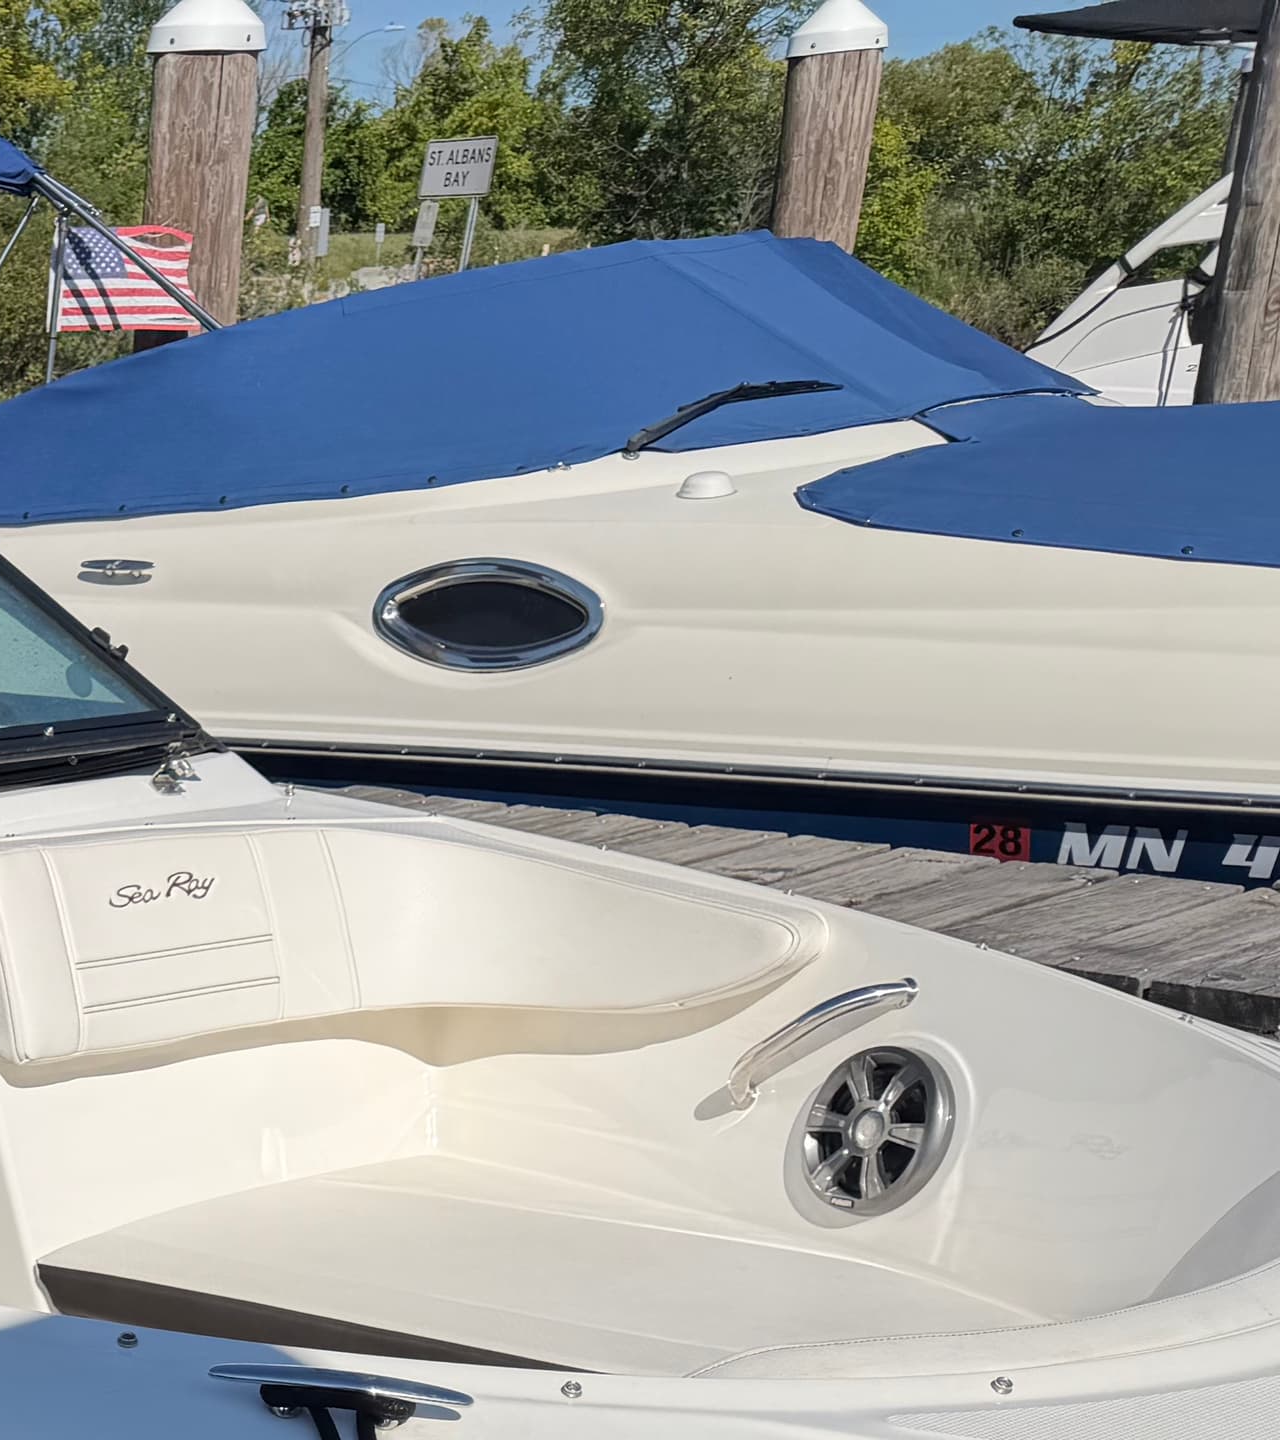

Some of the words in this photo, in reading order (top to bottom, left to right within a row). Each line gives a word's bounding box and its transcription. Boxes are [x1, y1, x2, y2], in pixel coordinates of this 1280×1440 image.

[428, 150, 444, 167] ST.
[446, 147, 492, 165] ALBANS
[443, 171, 470, 187] BAY
[973, 824, 1022, 856] 28
[1056, 822, 1189, 872] MN
[109, 884, 161, 908] Sea
[165, 871, 215, 899] Ray
